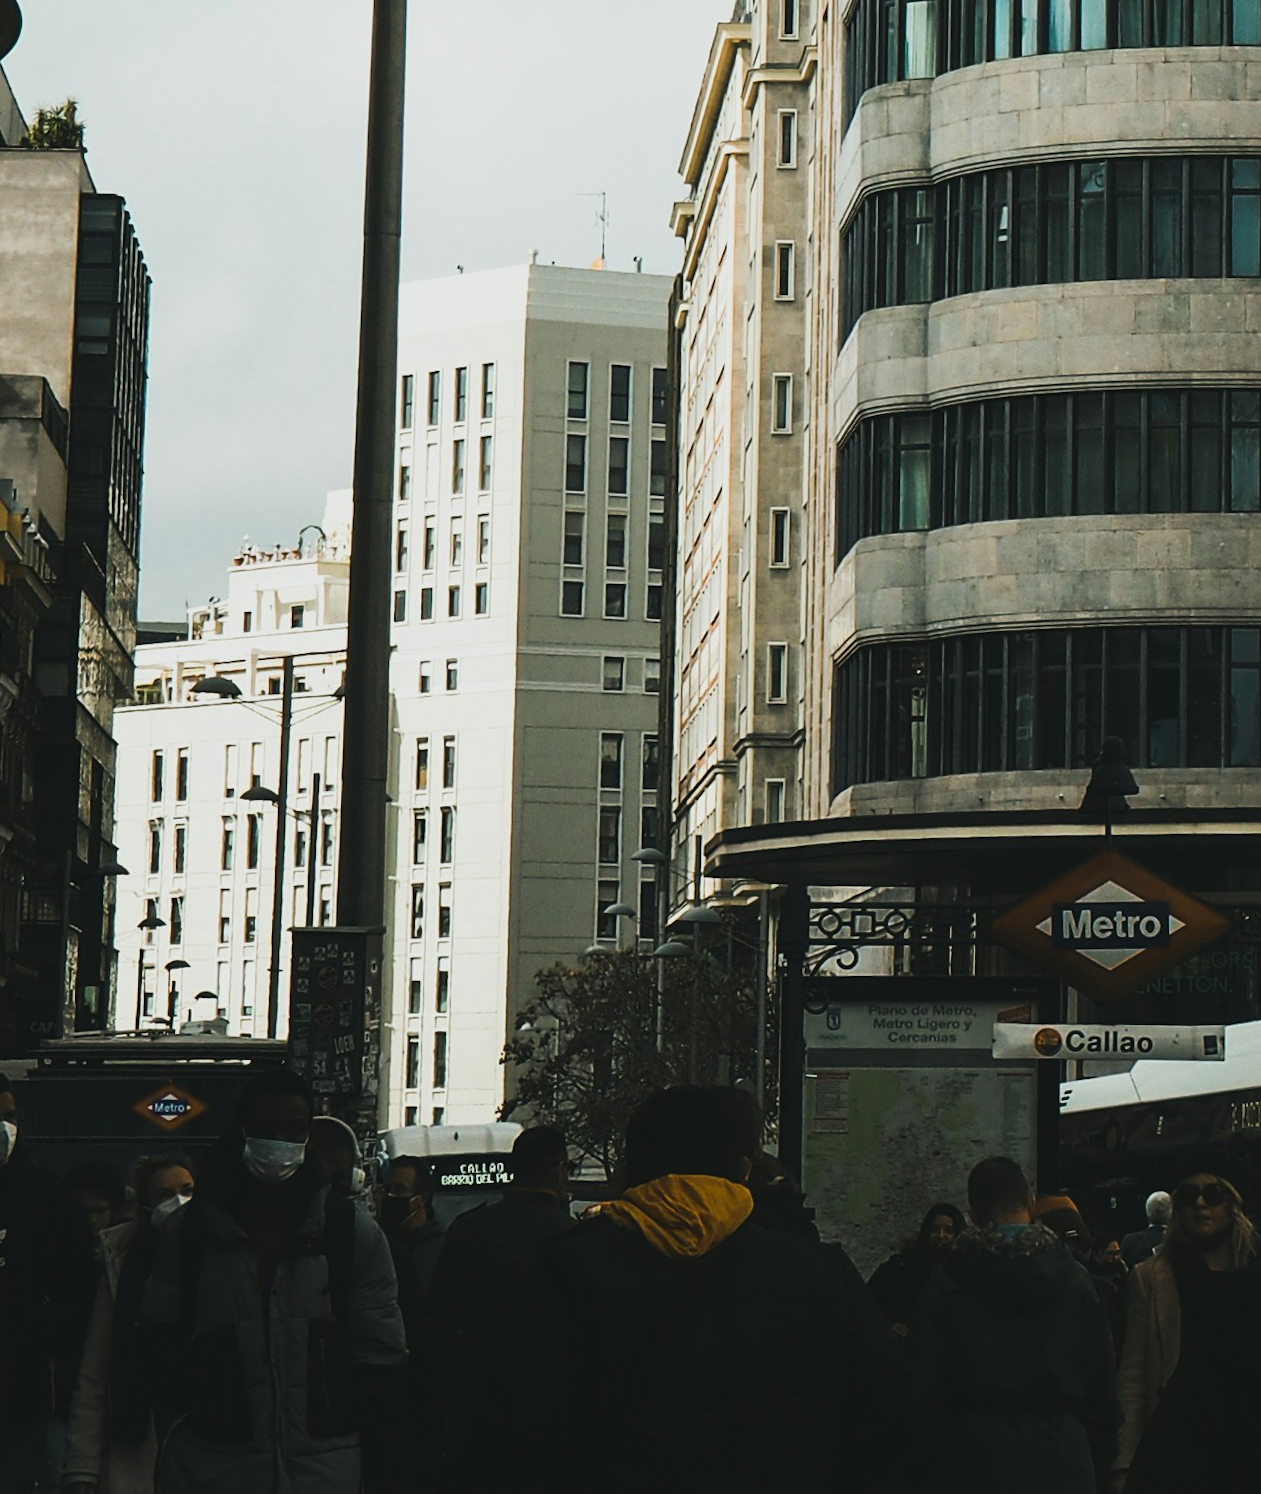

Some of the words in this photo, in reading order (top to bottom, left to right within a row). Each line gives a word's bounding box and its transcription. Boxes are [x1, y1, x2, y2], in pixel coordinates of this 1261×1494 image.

[1062, 909, 1161, 939] Metro
[869, 1005, 903, 1016] Plano
[911, 1005, 930, 1016] de
[873, 1019, 914, 1029] Metro
[917, 1019, 961, 1032] Ligero
[963, 1020, 972, 1032] y
[1066, 1030, 1153, 1054] Callao
[154, 1102, 185, 1114] Metro
[460, 1162, 505, 1174] CALLAO
[476, 1173, 494, 1185] DEL
